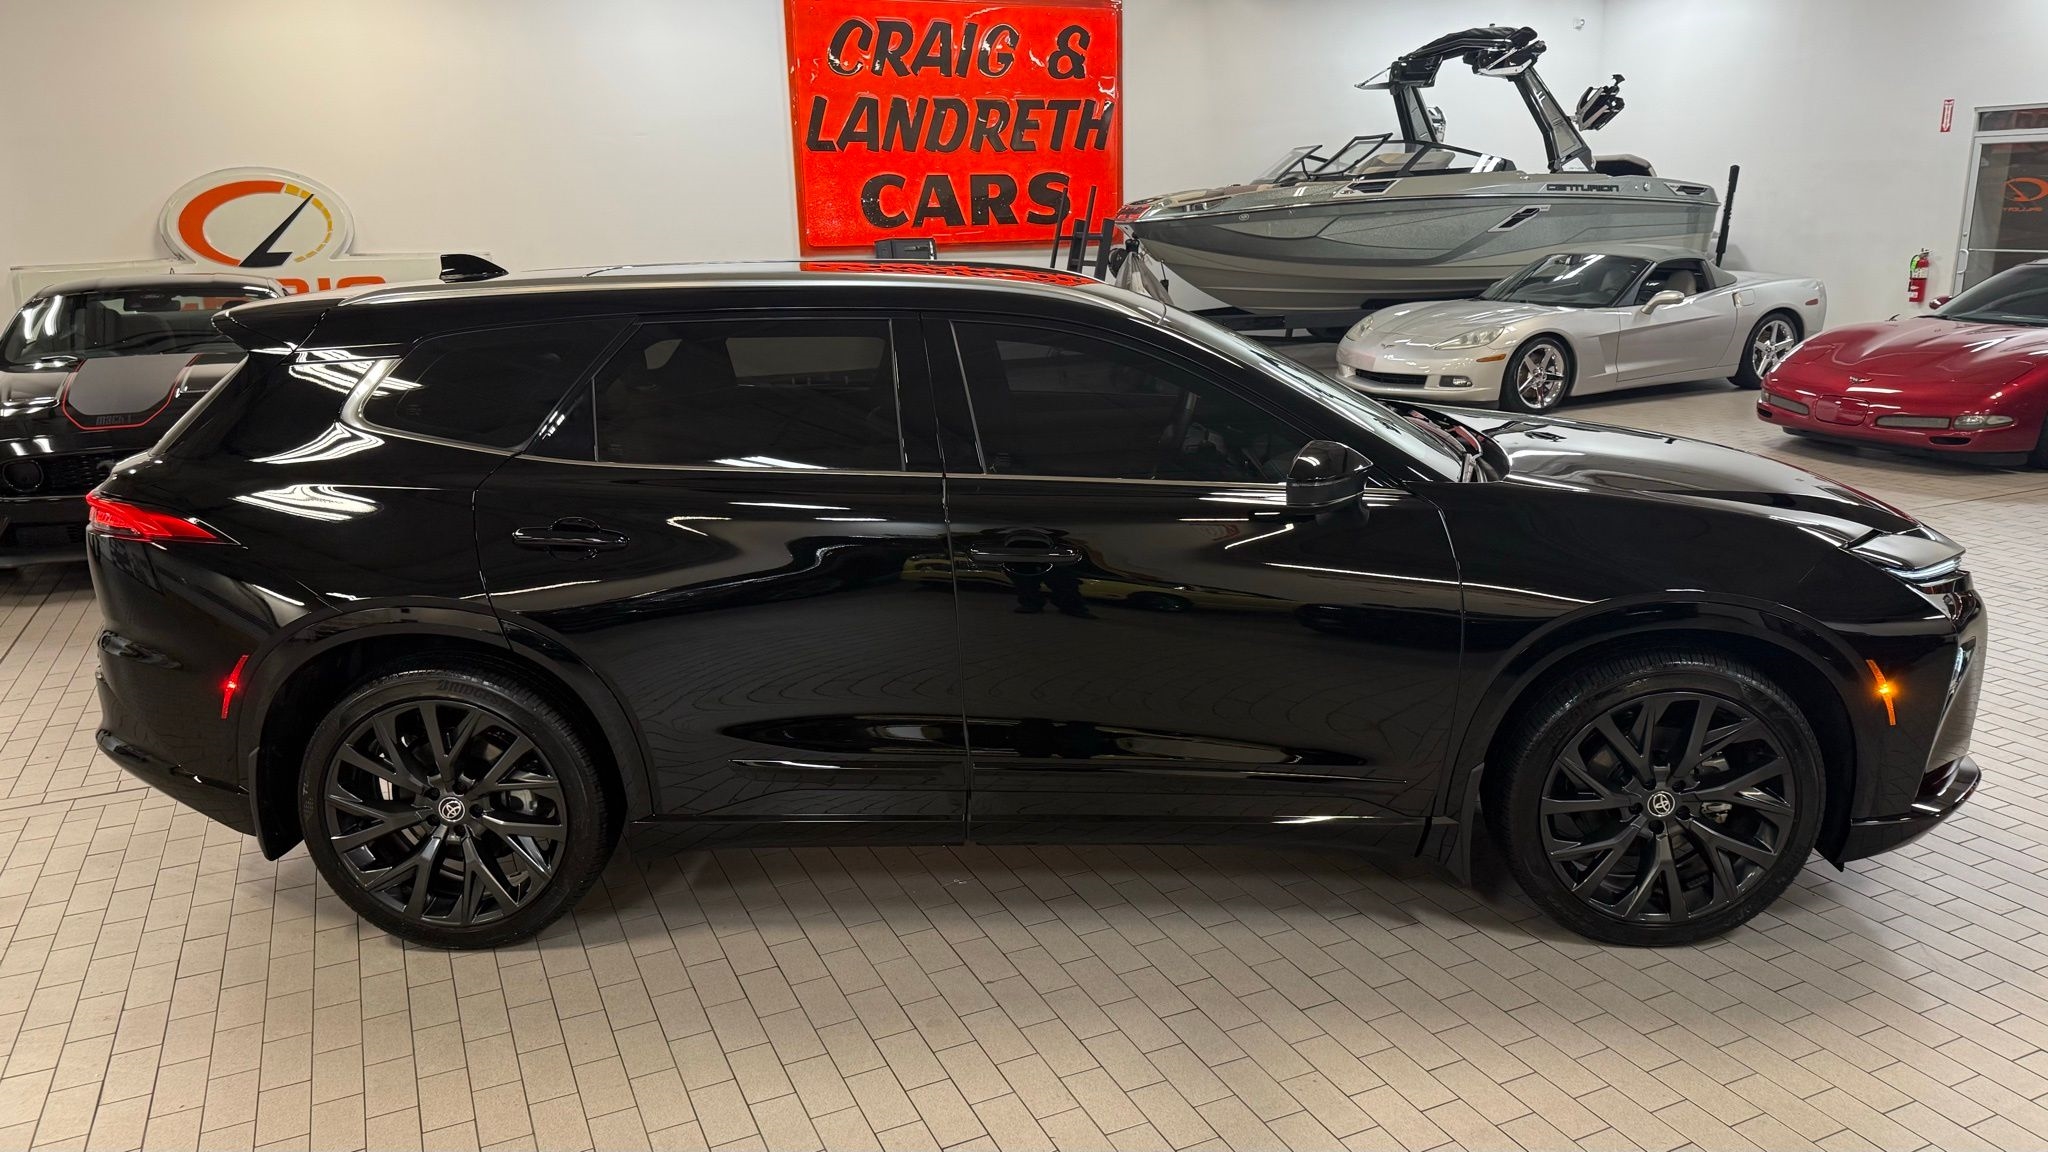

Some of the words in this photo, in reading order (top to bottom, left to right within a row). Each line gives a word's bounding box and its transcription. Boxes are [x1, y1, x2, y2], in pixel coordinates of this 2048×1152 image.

[827, 19, 1020, 77] CRAIG
[1047, 25, 1091, 79] &
[806, 96, 1114, 152] LANDRETH
[861, 172, 1072, 228] CARS
[1546, 184, 1620, 192] CENTURION
